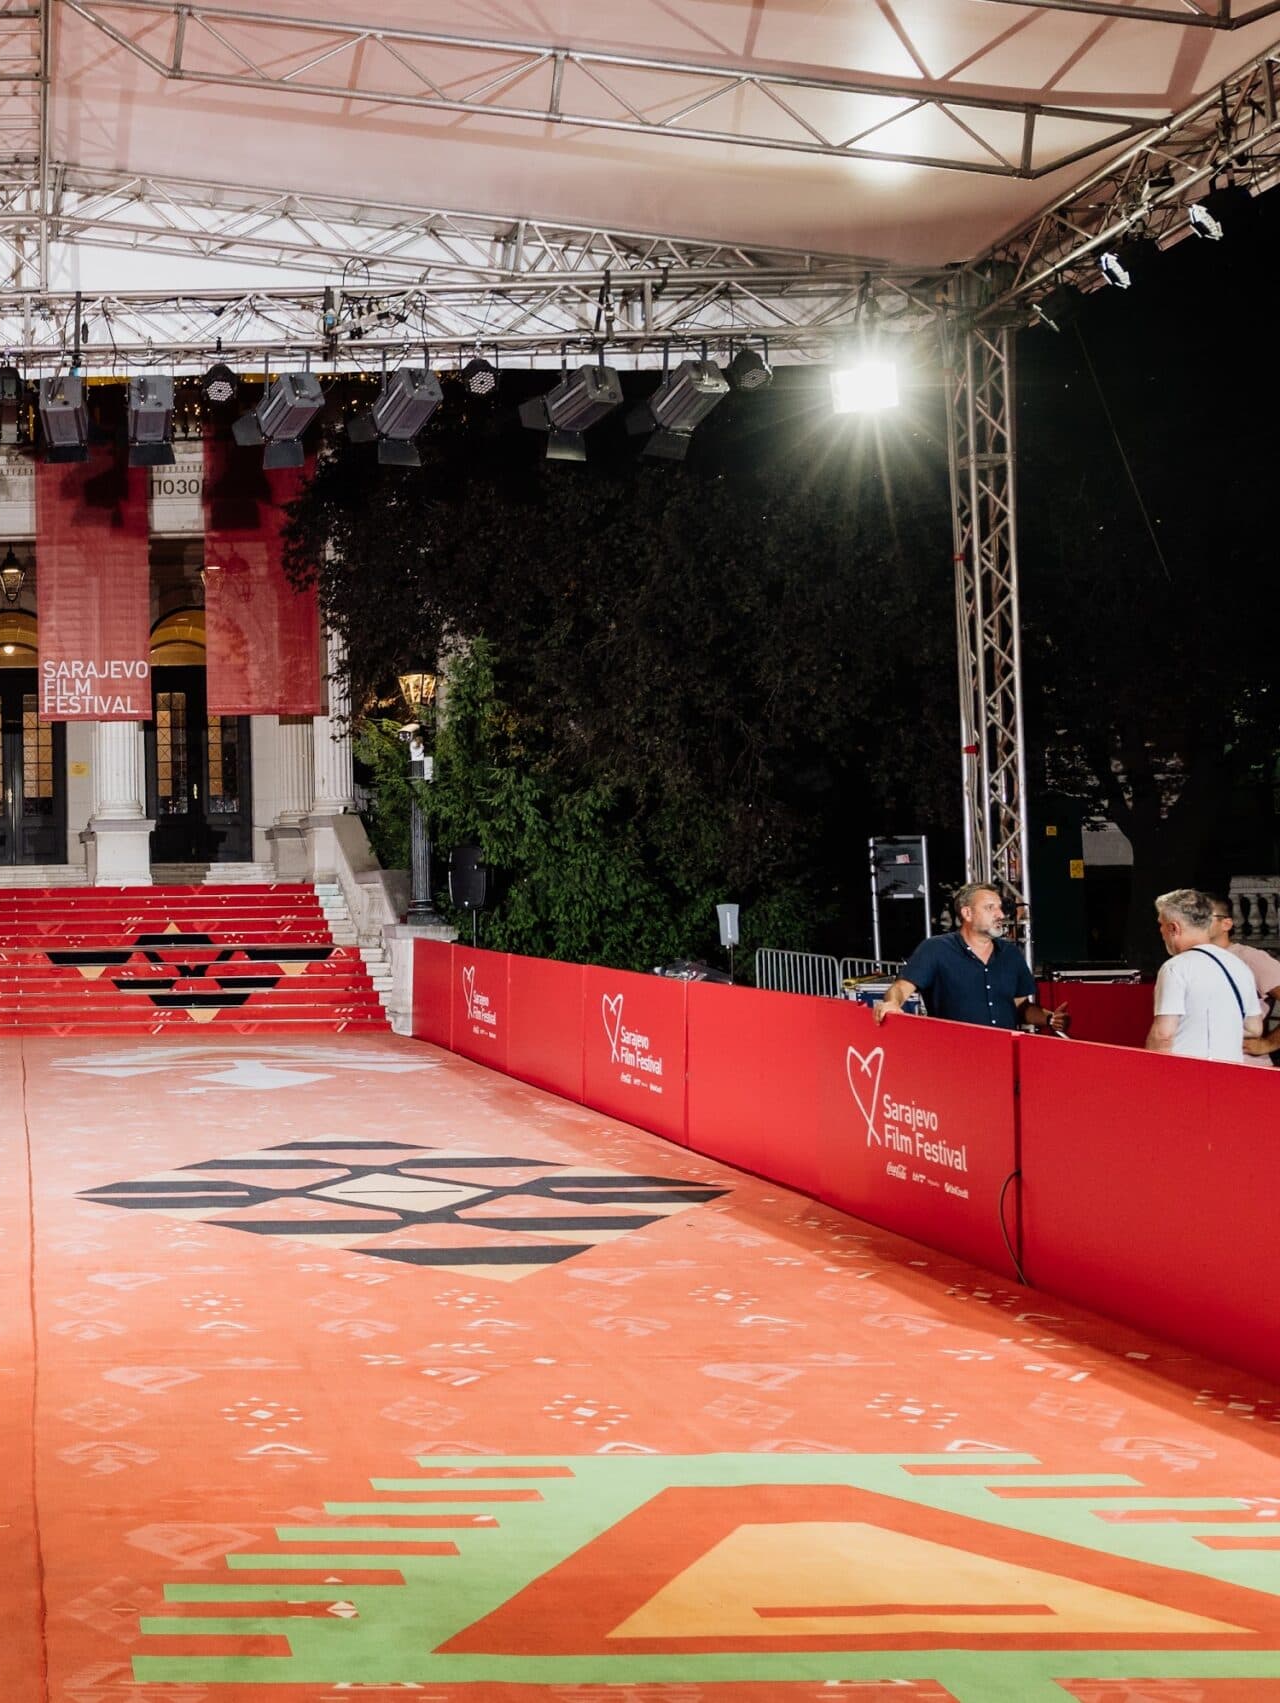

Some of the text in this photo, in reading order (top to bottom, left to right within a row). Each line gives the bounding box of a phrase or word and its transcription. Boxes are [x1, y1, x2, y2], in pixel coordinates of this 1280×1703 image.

[151, 479, 205, 496] ПОЗО
[43, 660, 149, 678] SARAJEVO
[44, 678, 91, 696] FILM
[44, 695, 139, 714] FESTIVAL
[620, 1025, 650, 1051] Sarajevo
[620, 1046, 662, 1076] Film Festival
[882, 1093, 938, 1132] Sarajevo
[884, 1123, 968, 1172] Film Festival
